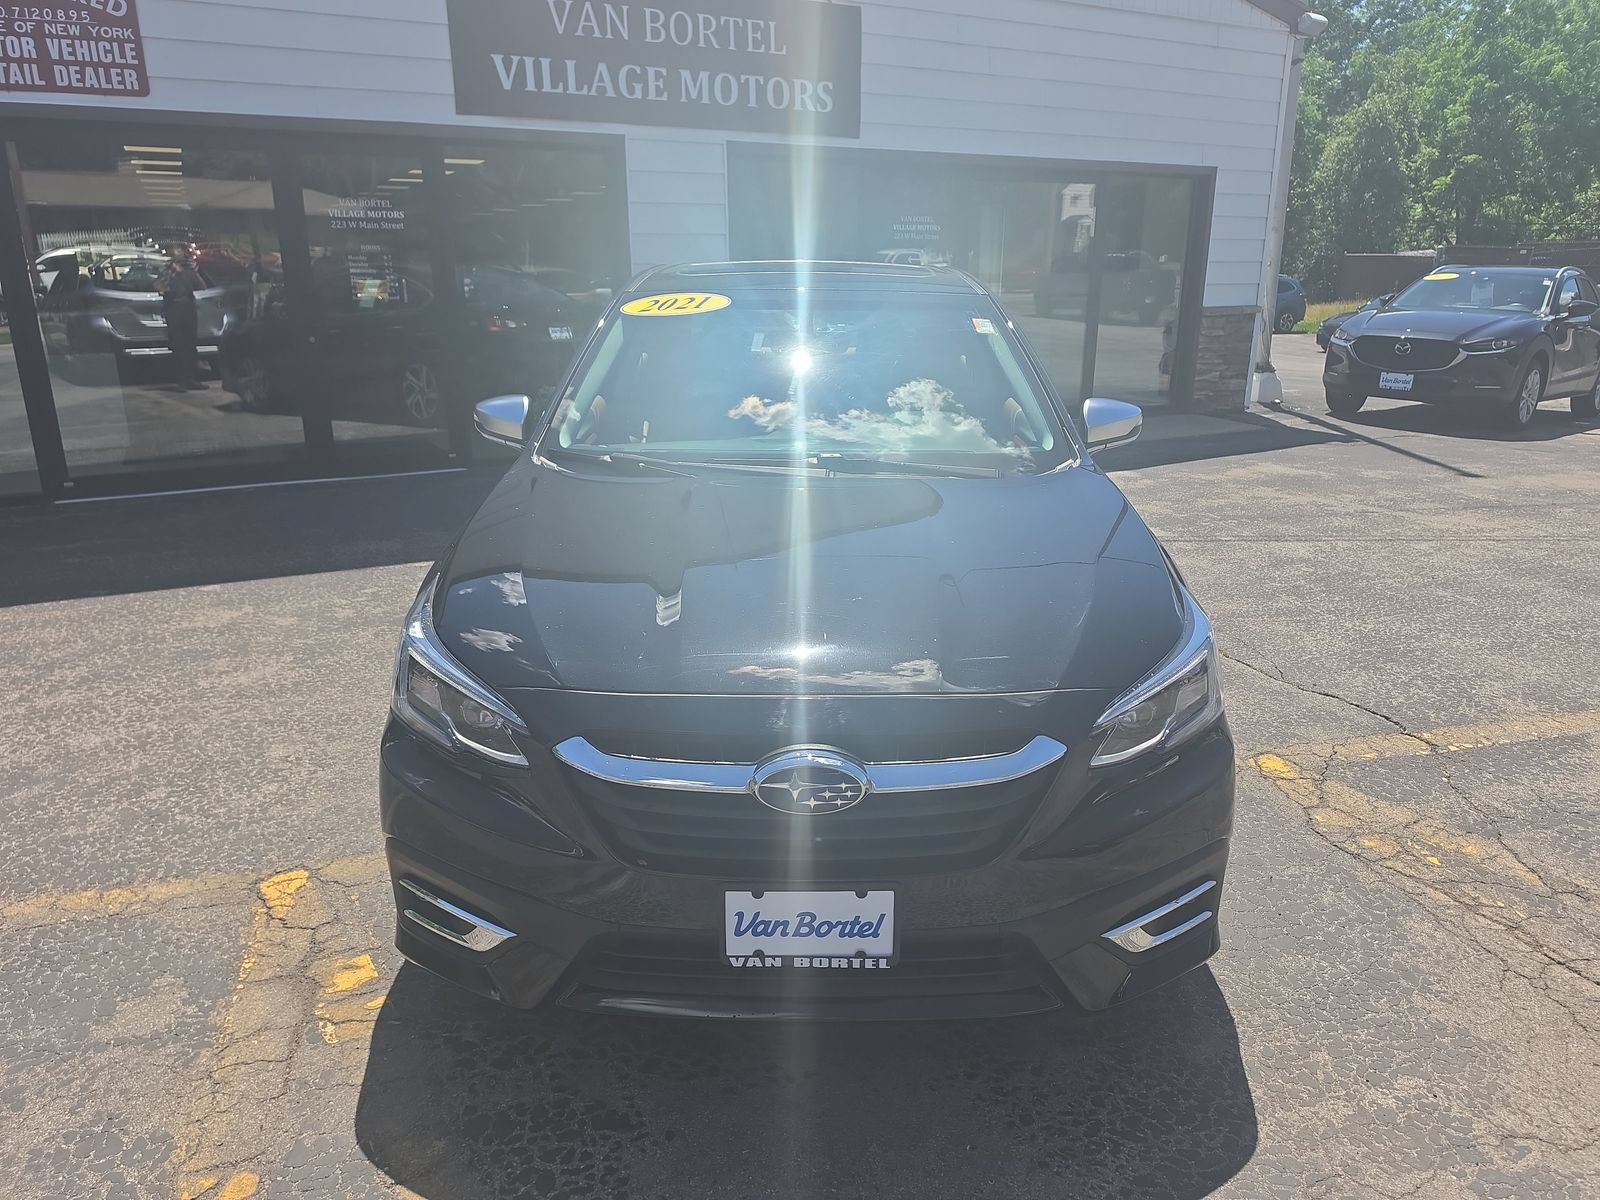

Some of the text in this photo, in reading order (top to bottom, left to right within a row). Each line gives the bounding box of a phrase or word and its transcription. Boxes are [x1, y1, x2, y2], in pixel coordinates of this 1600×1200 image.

[14, 21, 36, 33] OF
[44, 22, 81, 36] NEW
[88, 26, 135, 40] YORK
[547, 0, 787, 56] VAN BORTEL
[46, 38, 139, 65] VEHICLE
[53, 65, 139, 90] DEALER
[490, 53, 834, 113] VILLAGE MOTORS
[328, 209, 405, 219] VILLAGE MOTORS
[331, 220, 405, 230] 223 W Main Street
[637, 296, 712, 313] 2021
[733, 911, 887, 939] Van Bortel
[728, 957, 891, 969] VAN BORTEL
